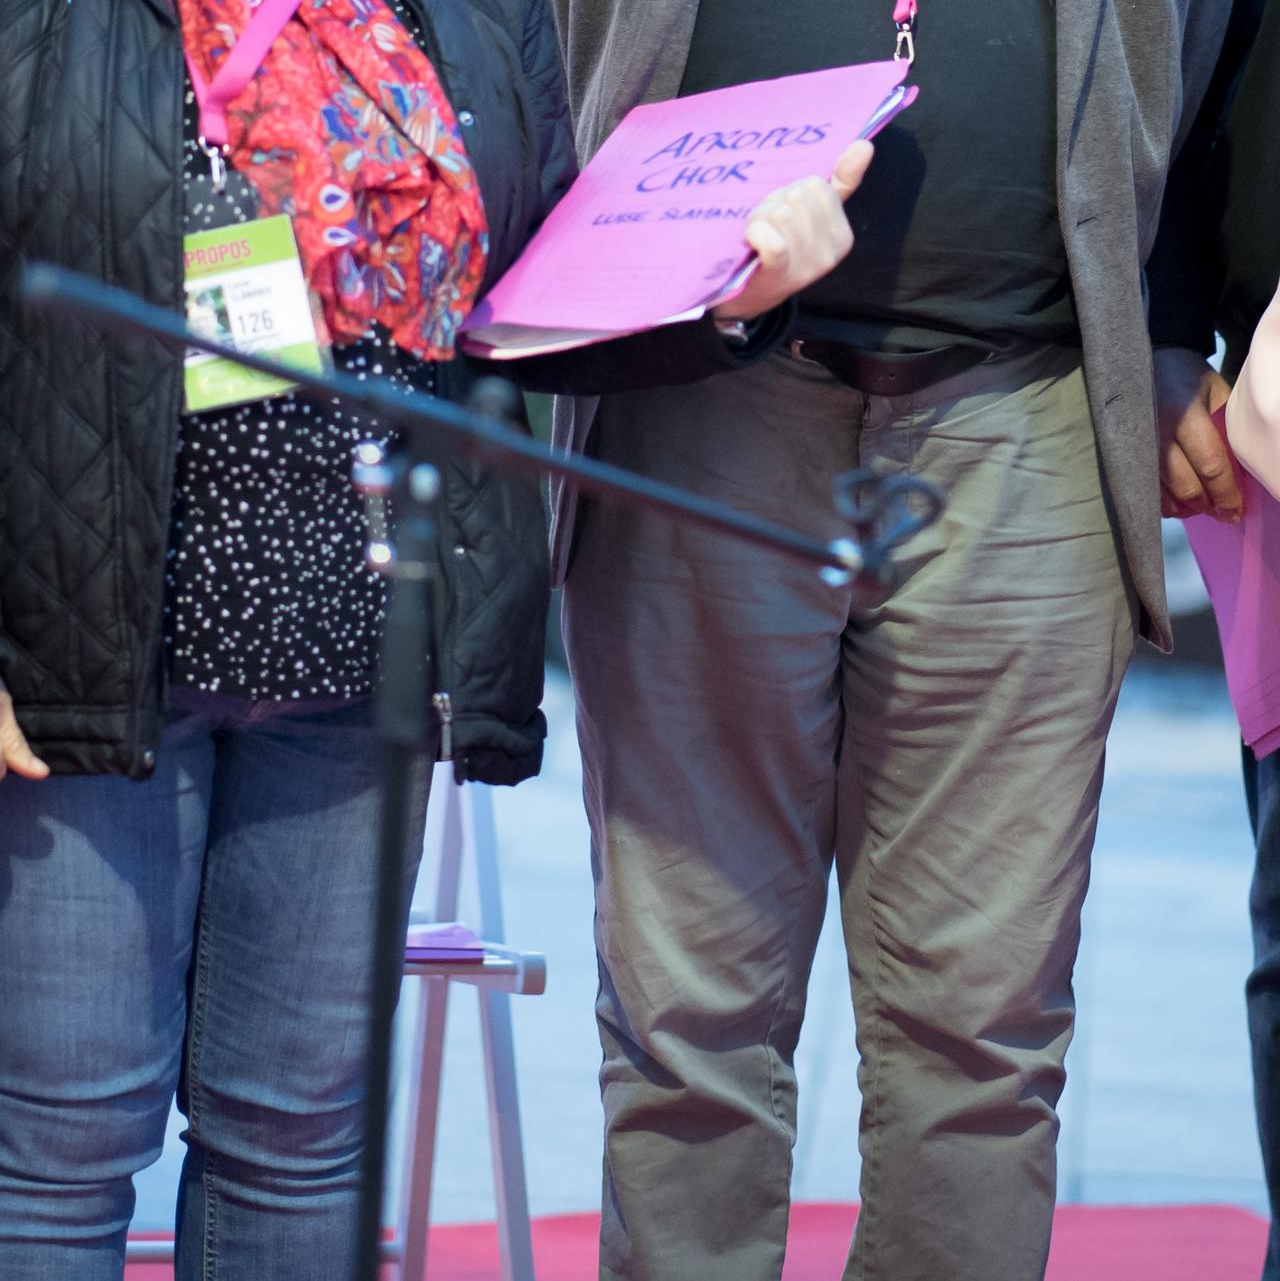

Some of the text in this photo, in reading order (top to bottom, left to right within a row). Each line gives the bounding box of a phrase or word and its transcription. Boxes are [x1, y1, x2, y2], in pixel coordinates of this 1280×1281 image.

[642, 123, 832, 165] APROPOS
[635, 160, 754, 193] CHOR
[237, 309, 274, 336] 126
